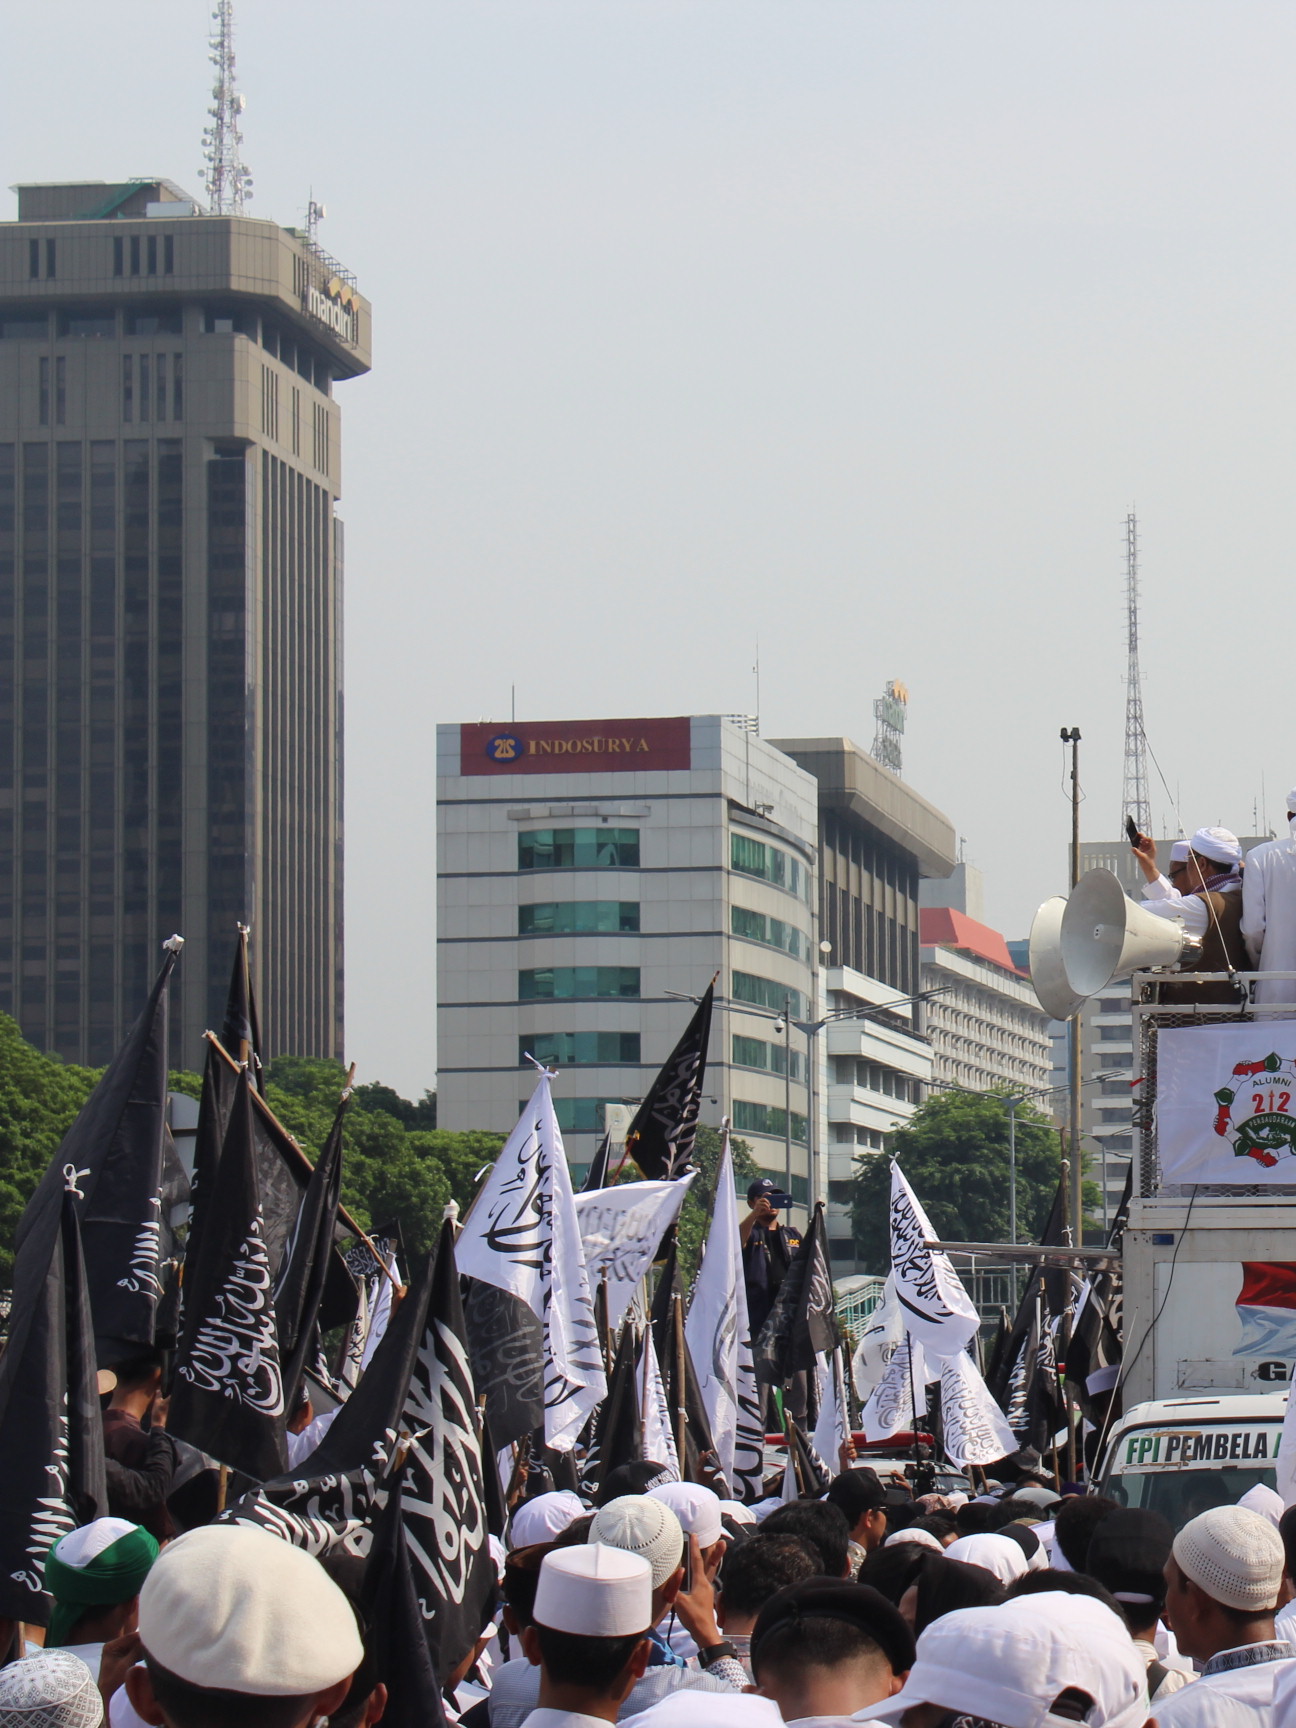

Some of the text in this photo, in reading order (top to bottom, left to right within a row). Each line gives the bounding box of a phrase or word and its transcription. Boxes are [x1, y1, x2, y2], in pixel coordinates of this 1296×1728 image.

[528, 737, 650, 755] INDOSURYA
[1252, 1076, 1292, 1088] ALUMNI
[1126, 1436, 1160, 1465] FPI
[1165, 1431, 1268, 1462] PEMBELA
